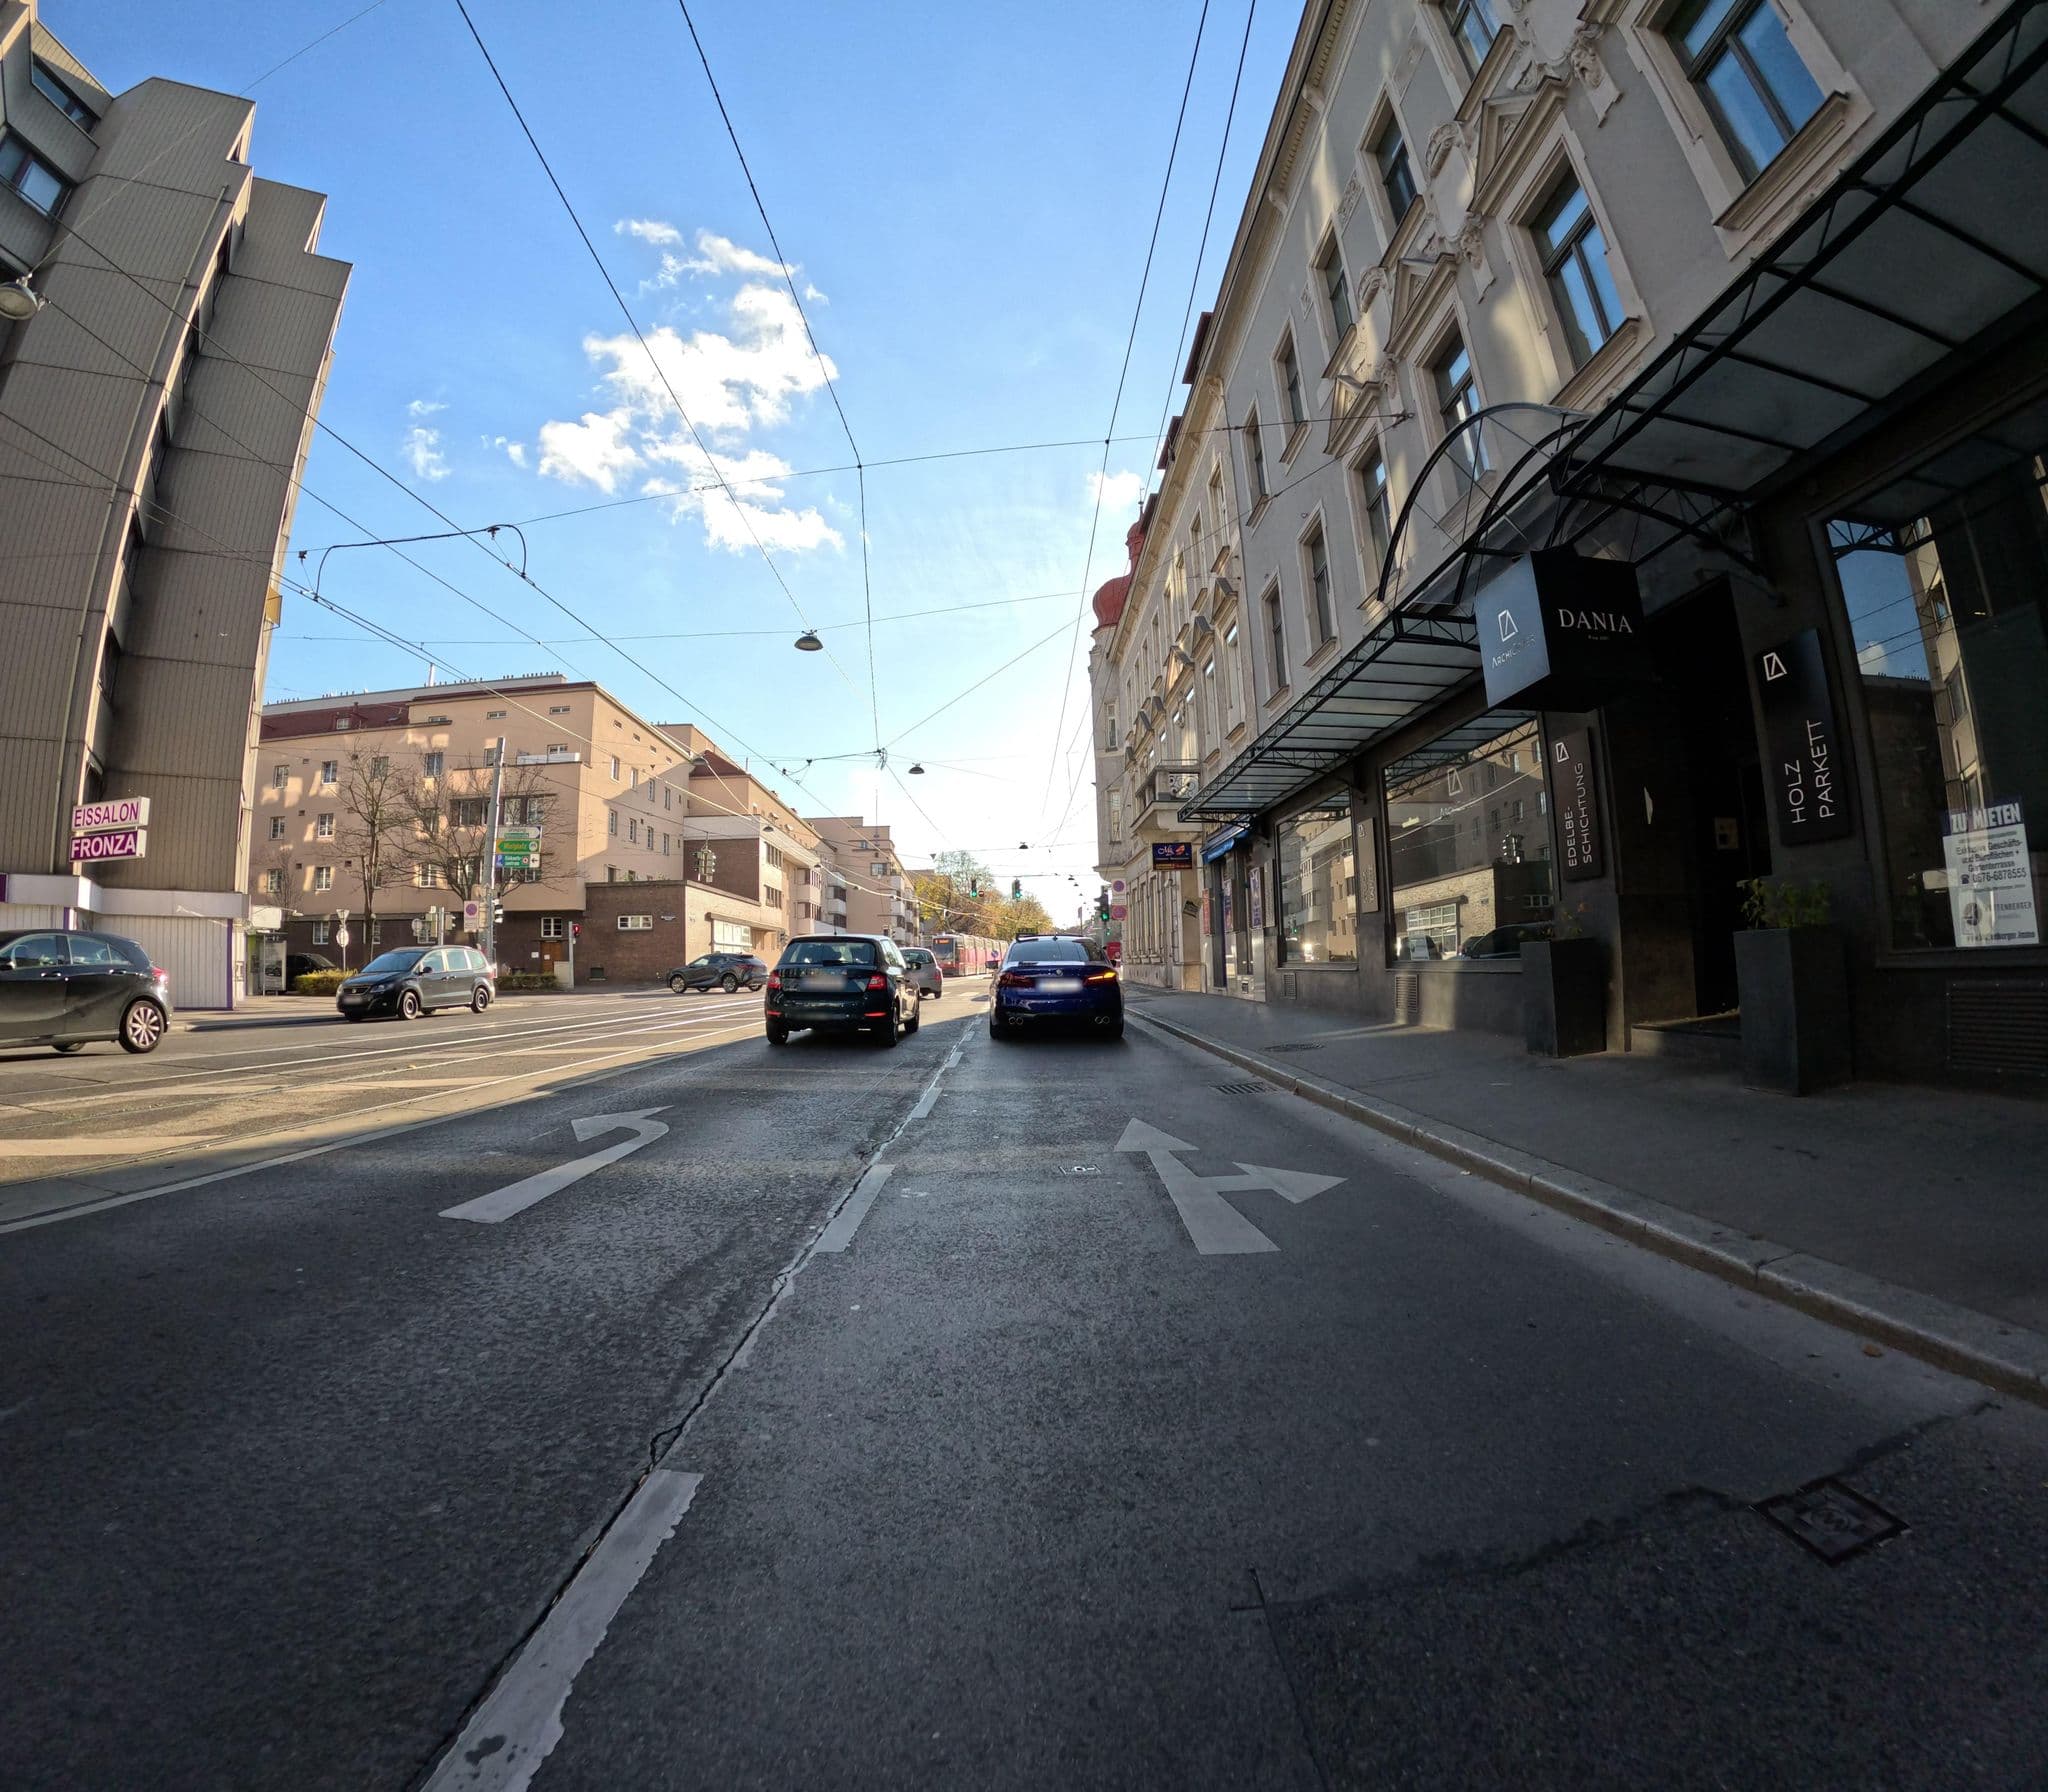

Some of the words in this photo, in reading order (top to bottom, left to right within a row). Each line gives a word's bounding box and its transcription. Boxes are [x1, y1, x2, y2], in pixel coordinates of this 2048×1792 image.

[1558, 608, 1633, 633] DANIA
[1784, 760, 1807, 824] HOLZ
[1807, 720, 1836, 818] PARKETT
[74, 802, 139, 827] EISSALON
[1574, 761, 1593, 864] SCHICHTUNG
[1951, 812, 1967, 832] ZU
[1973, 802, 2022, 831] MIETEN
[71, 833, 136, 859] FRONZA
[1564, 805, 1578, 868] EDELBE-
